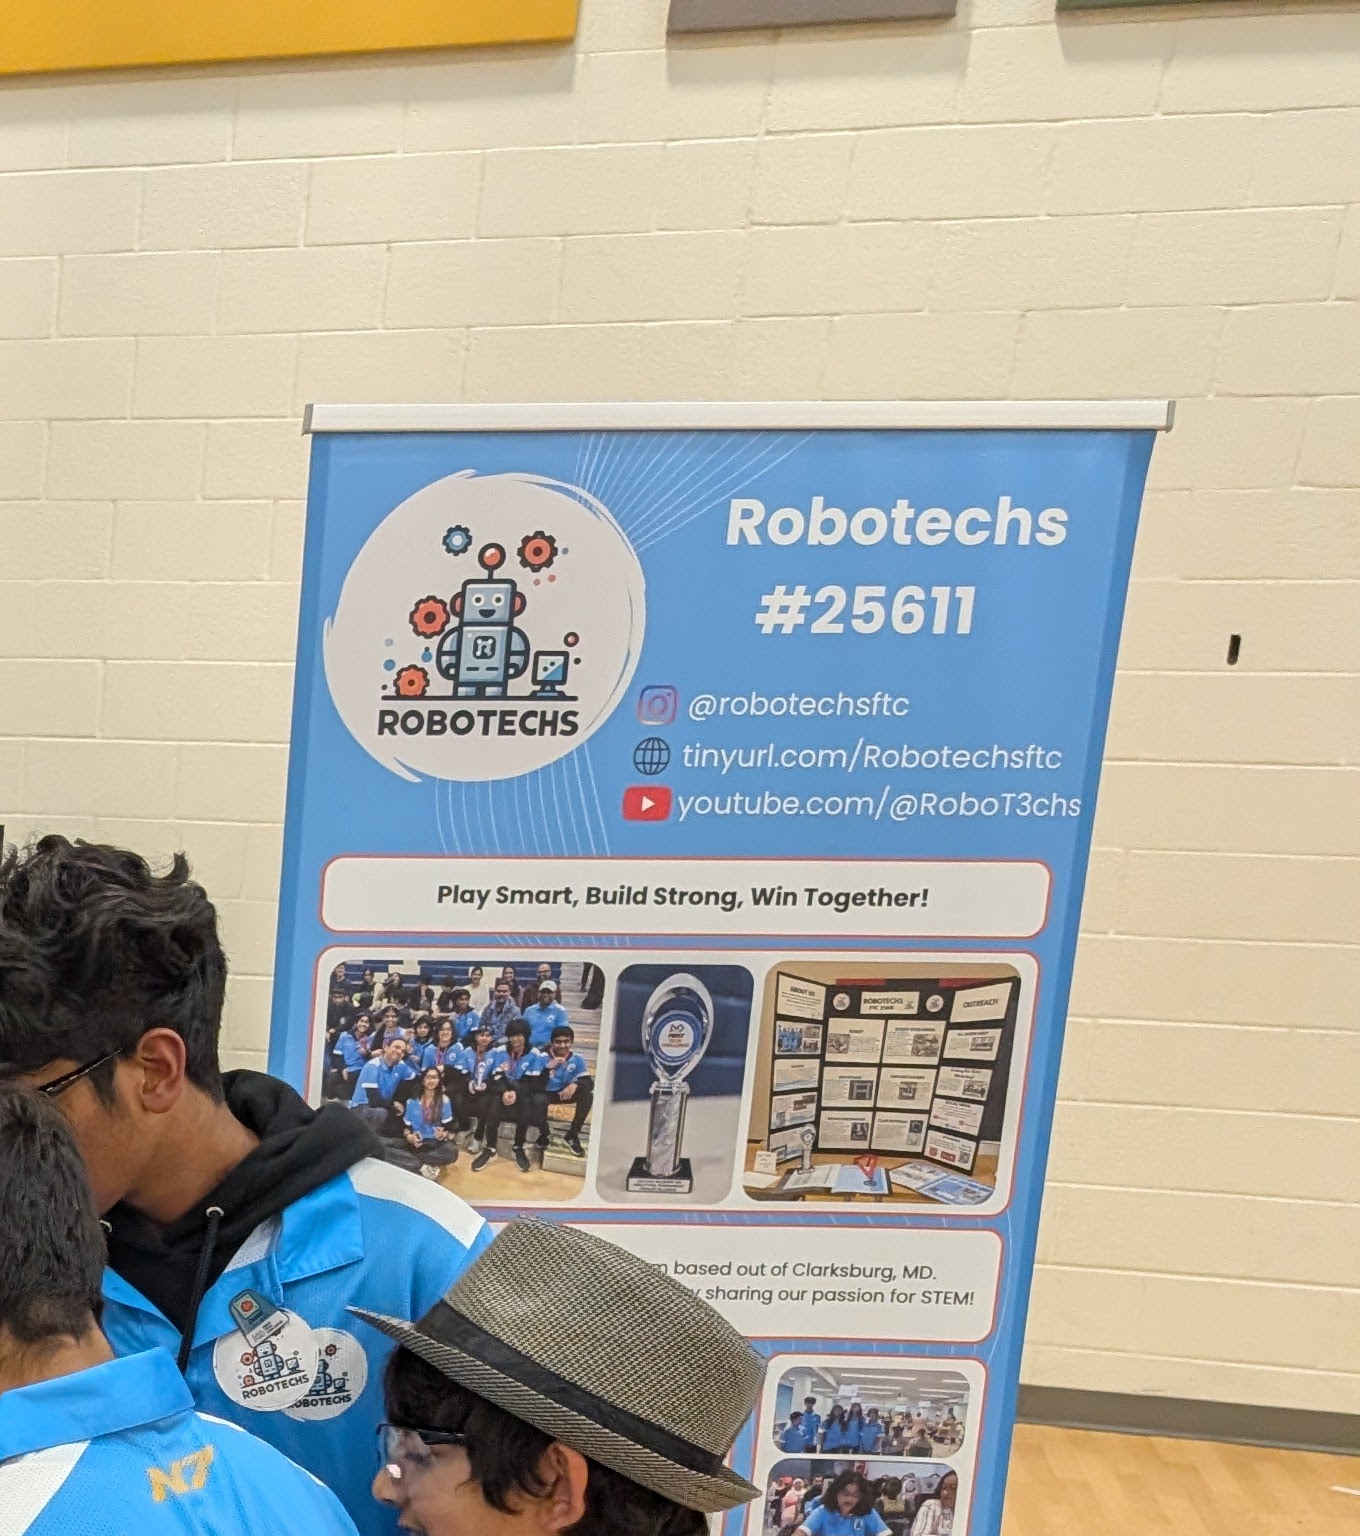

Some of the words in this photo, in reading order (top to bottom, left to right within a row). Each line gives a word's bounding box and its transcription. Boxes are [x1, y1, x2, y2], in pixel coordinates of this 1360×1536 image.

[726, 496, 1069, 547] Robotechs
[755, 585, 977, 635] #25611
[689, 691, 909, 719] @robotechsftc
[377, 709, 579, 737] ROBOTECHS
[683, 741, 1062, 774] tinyurl.com/Robotechsftc
[678, 788, 1081, 822] youtube.com/@RoboT3chs
[437, 886, 490, 910] Play
[496, 887, 579, 908] Smart,
[585, 885, 647, 906] Build
[654, 887, 743, 911] Strong,
[751, 887, 798, 906] Win
[804, 887, 929, 913] Together!
[963, 998, 998, 1008] OUTREACH
[674, 1261, 731, 1276] based
[737, 1263, 767, 1277] out
[771, 1262, 789, 1277] of
[792, 1263, 897, 1282] Clarksburg,
[903, 1266, 937, 1279] MD.
[706, 1287, 773, 1305] sharing
[778, 1289, 807, 1302] our
[812, 1288, 884, 1305] passion
[890, 1288, 915, 1303] for
[920, 1290, 974, 1305] STEM!
[242, 1374, 310, 1400] ROBOTECHS
[146, 1445, 214, 1504] N7
